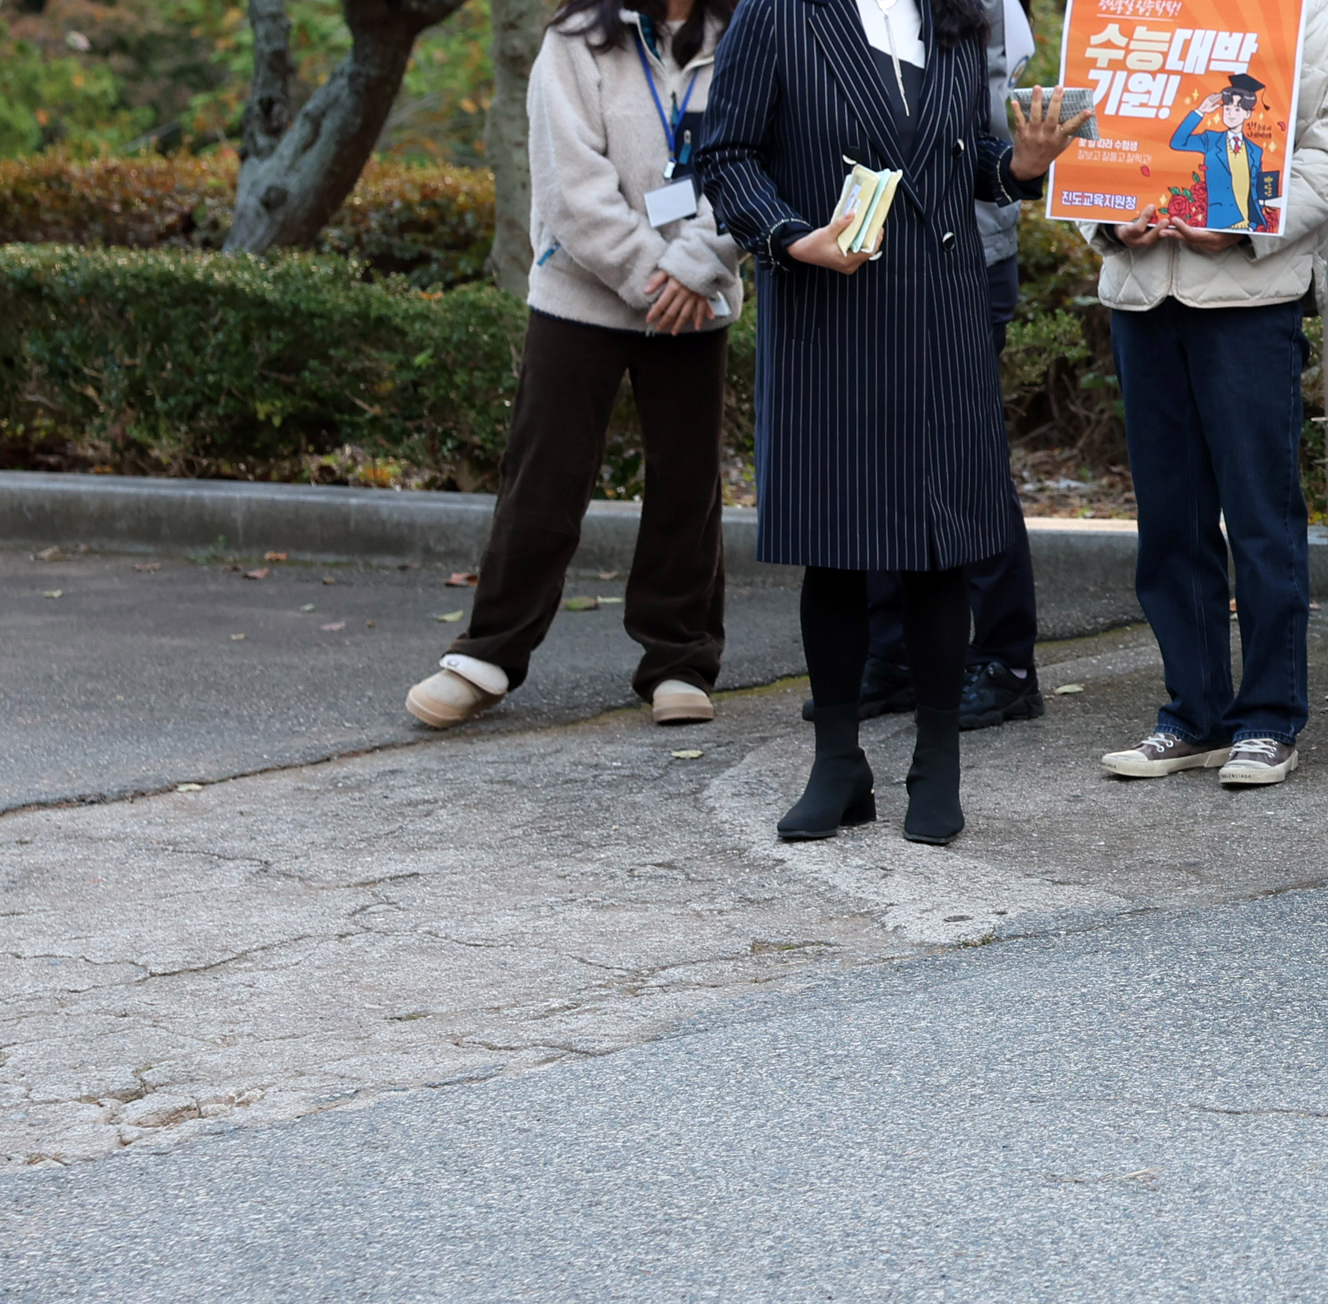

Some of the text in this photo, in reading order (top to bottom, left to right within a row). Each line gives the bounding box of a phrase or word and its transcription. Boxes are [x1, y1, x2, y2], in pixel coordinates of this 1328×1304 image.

[1085, 24, 1258, 75] 수능대박
[1087, 70, 1181, 120] 기원!
[1114, 140, 1138, 151] 수험생
[1061, 190, 1137, 211] 진도교육지원청
